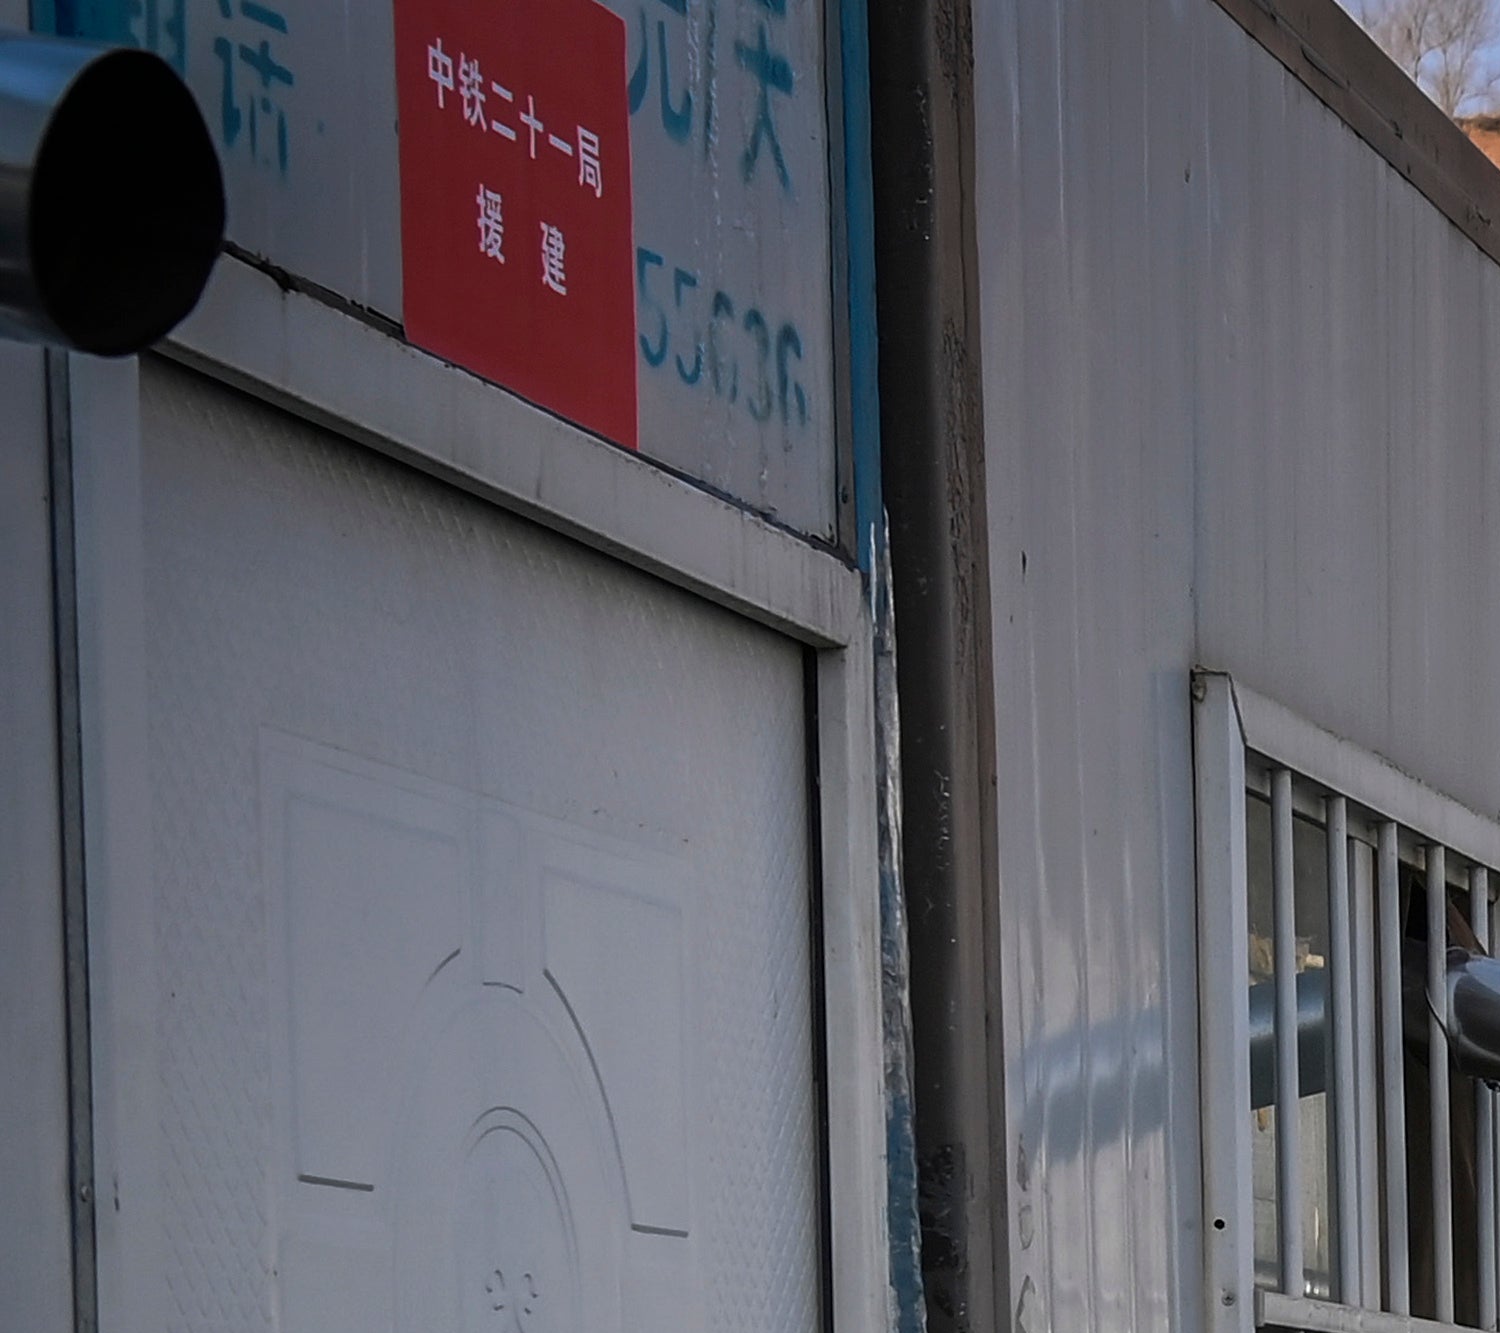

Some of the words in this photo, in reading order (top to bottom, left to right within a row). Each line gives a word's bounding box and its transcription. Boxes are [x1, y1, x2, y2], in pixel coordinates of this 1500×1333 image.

[427, 37, 602, 198] 中铁二十一局
[476, 183, 567, 296] 援建
